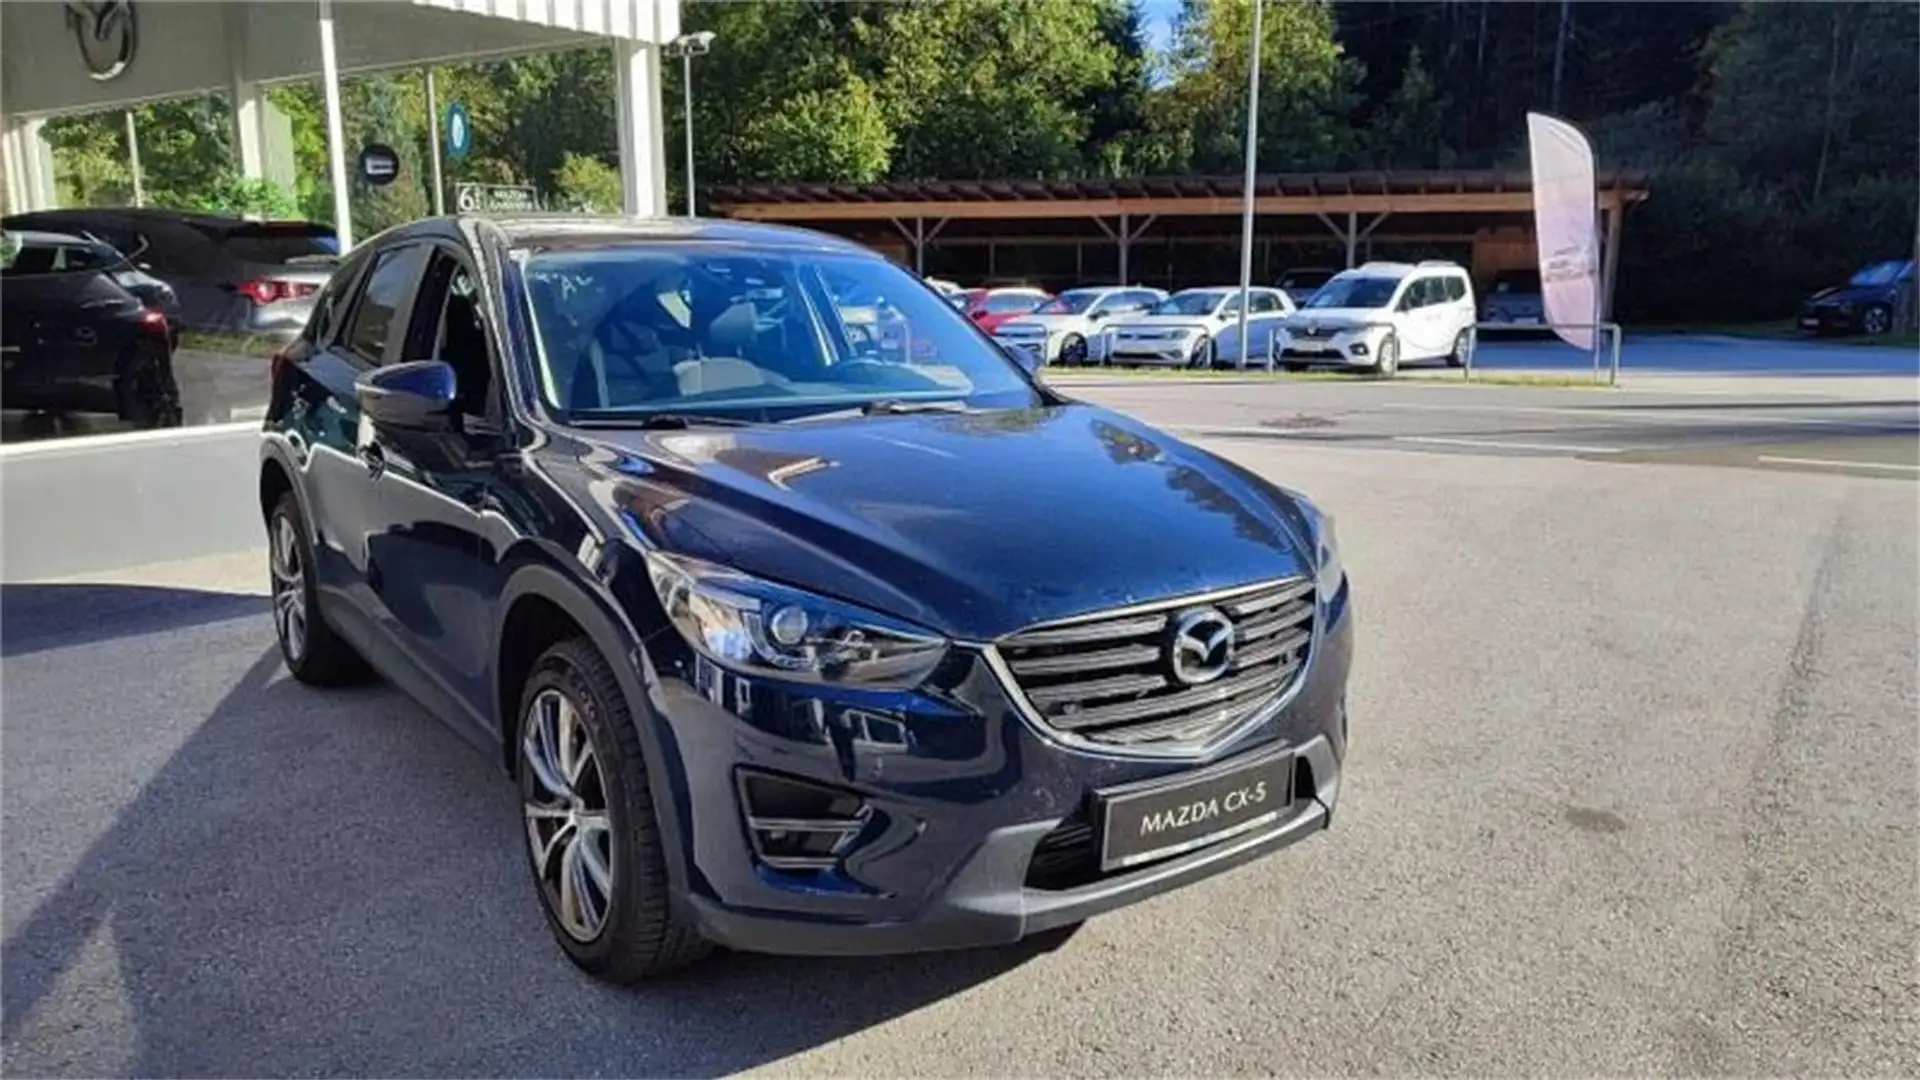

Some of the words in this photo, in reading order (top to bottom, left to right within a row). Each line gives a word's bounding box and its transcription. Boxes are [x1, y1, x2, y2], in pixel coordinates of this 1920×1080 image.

[460, 187, 474, 211] 6
[1140, 797, 1220, 837] MAZDA
[1223, 780, 1268, 812] CX-5
